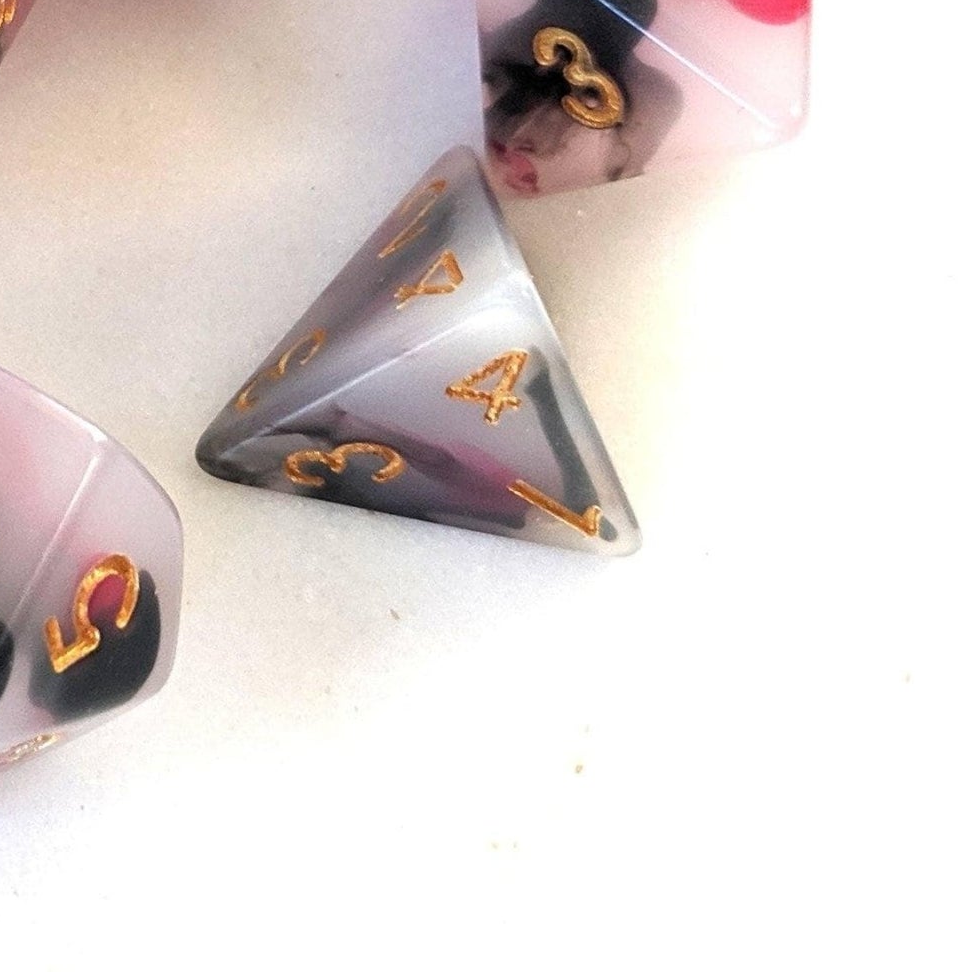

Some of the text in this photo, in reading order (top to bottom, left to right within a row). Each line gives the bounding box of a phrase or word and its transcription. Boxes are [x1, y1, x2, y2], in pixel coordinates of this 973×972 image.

[532, 27, 625, 129] 3
[393, 249, 464, 310] 4
[445, 348, 528, 425] 4
[283, 441, 405, 486] 3
[507, 478, 603, 538] 1
[43, 552, 140, 674] 5
